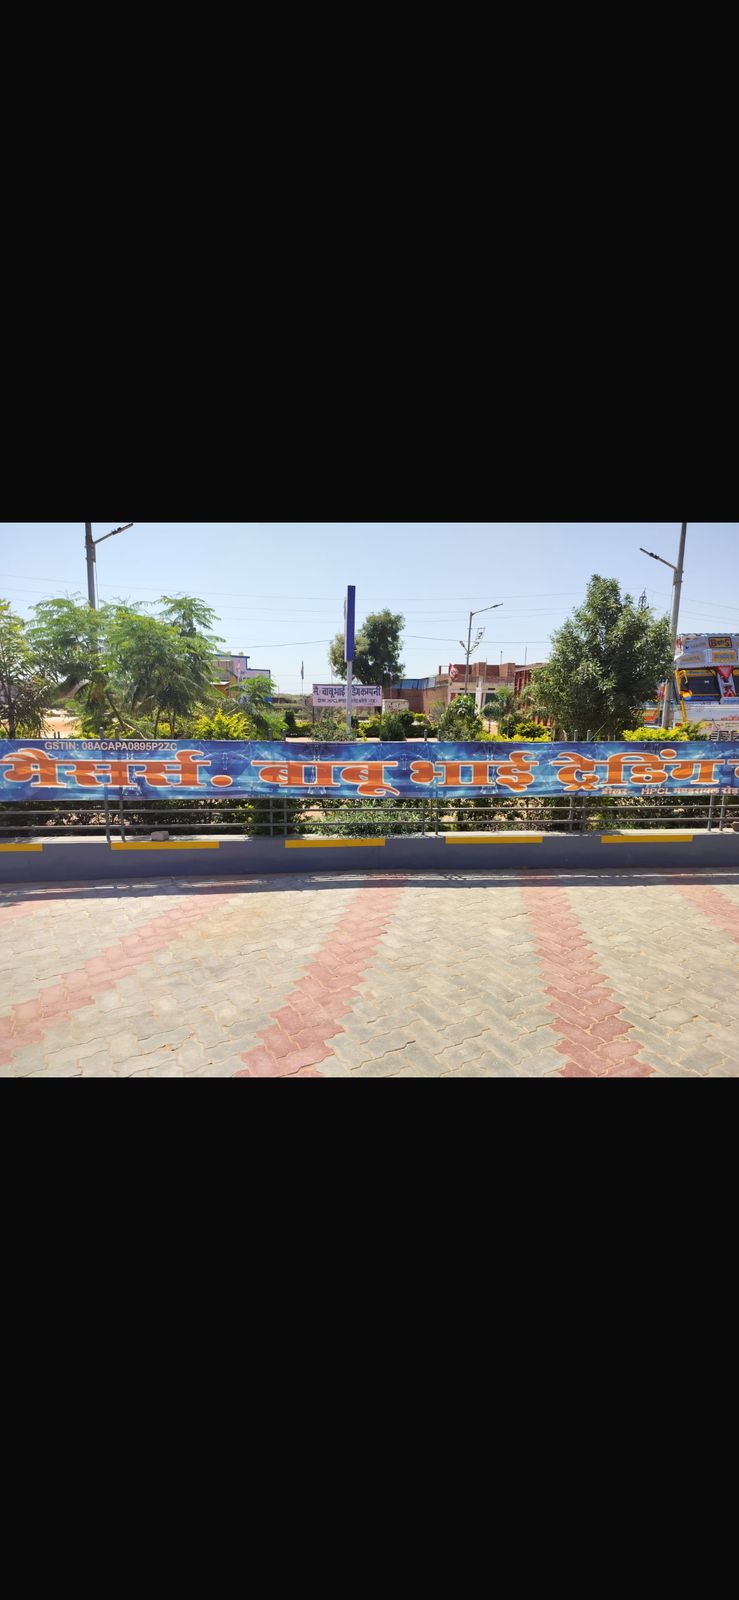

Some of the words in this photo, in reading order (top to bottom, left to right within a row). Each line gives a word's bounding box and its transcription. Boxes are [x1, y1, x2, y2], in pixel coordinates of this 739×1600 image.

[44, 741, 79, 751] GSTIN:
[81, 741, 178, 752] 08ACAPA0895P2ZC
[250, 760, 400, 796] बाबू
[409, 749, 539, 792] भाई
[551, 748, 725, 792] ट्रेडिंग
[641, 787, 672, 795] HPCL
